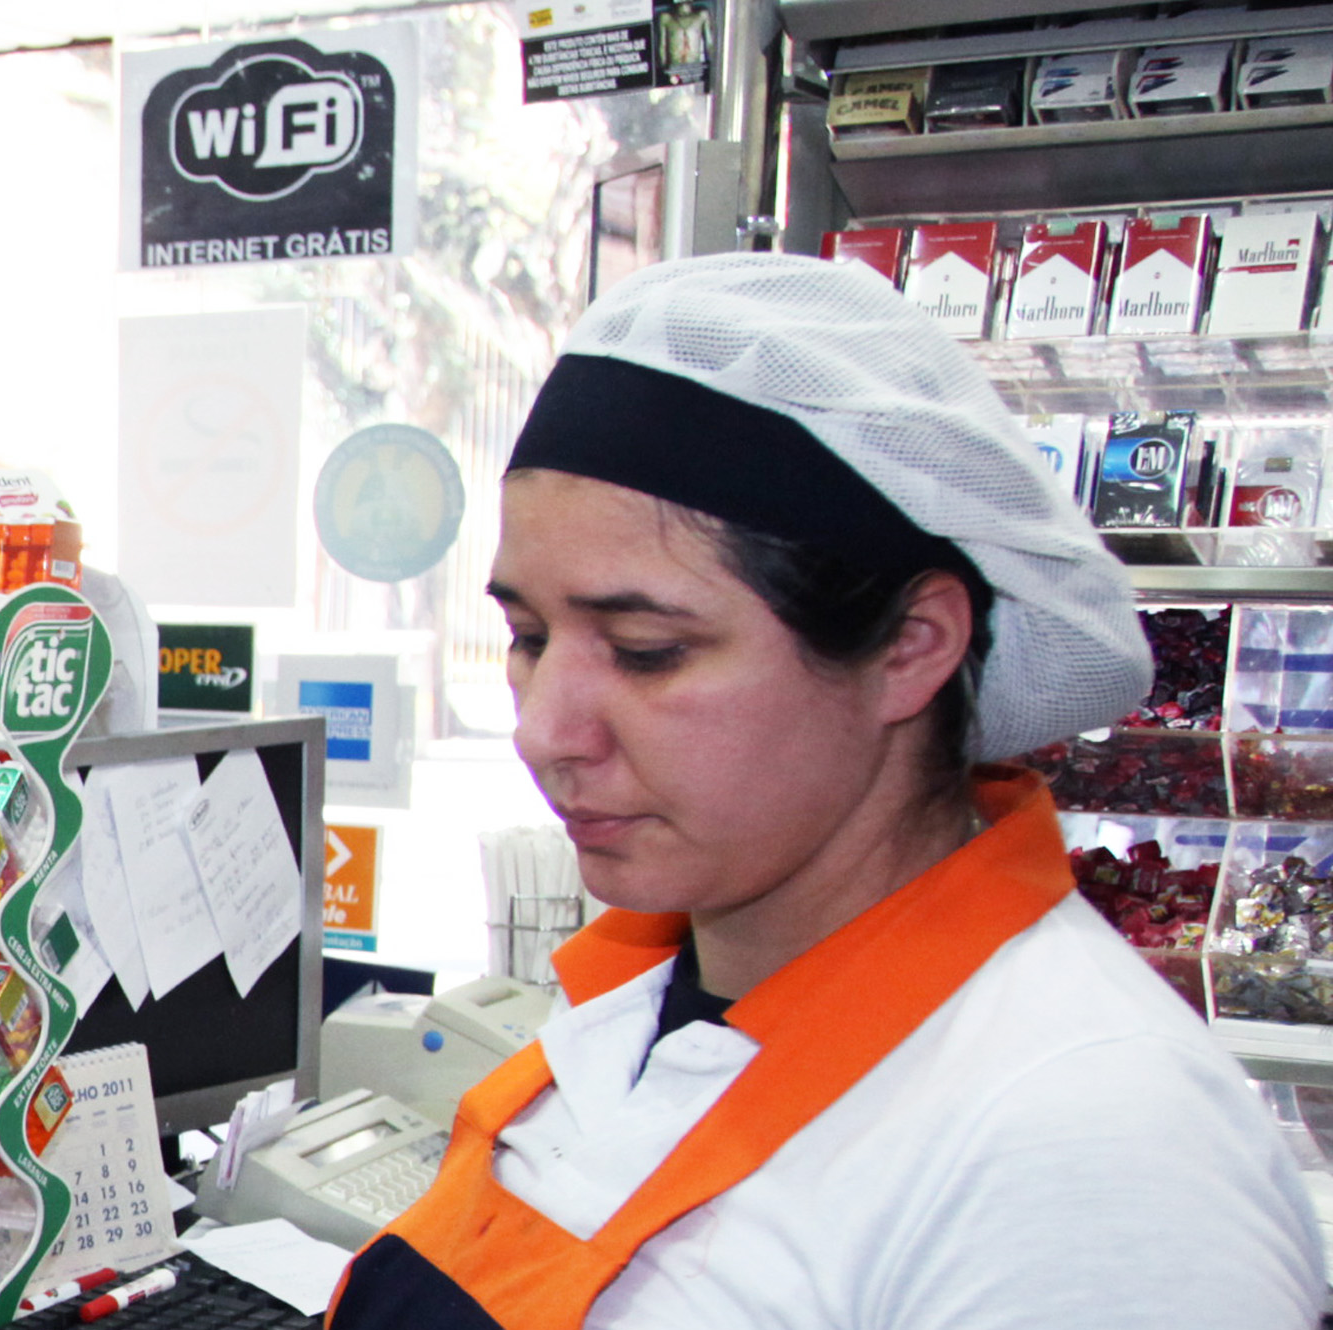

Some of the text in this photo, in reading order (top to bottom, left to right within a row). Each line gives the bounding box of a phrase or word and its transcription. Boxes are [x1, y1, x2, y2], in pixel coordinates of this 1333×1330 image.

[836, 99, 900, 116] CAMEL
[146, 235, 279, 266] INTERNET
[1238, 241, 1300, 264] Marlboro
[917, 293, 978, 319] arlboro
[1119, 291, 1190, 318] Marlboro
[30, 635, 76, 682] tic
[159, 647, 222, 675] OPER
[16, 675, 73, 718] tac
[33, 850, 58, 887] MENTA
[323, 882, 359, 904] BAL
[13, 1071, 38, 1109] EXTRA
[73, 1077, 134, 1104] LHO 2011
[100, 1138, 135, 1157] 1 2
[17, 1152, 49, 1188] LARANJA
[75, 1158, 137, 1186] 7 8 9
[74, 1179, 146, 1208] 14 15 16
[75, 1199, 149, 1230] 21 22 23
[77, 1233, 95, 1250] 28
[105, 1226, 124, 1244] 29
[135, 1221, 153, 1238] 30
